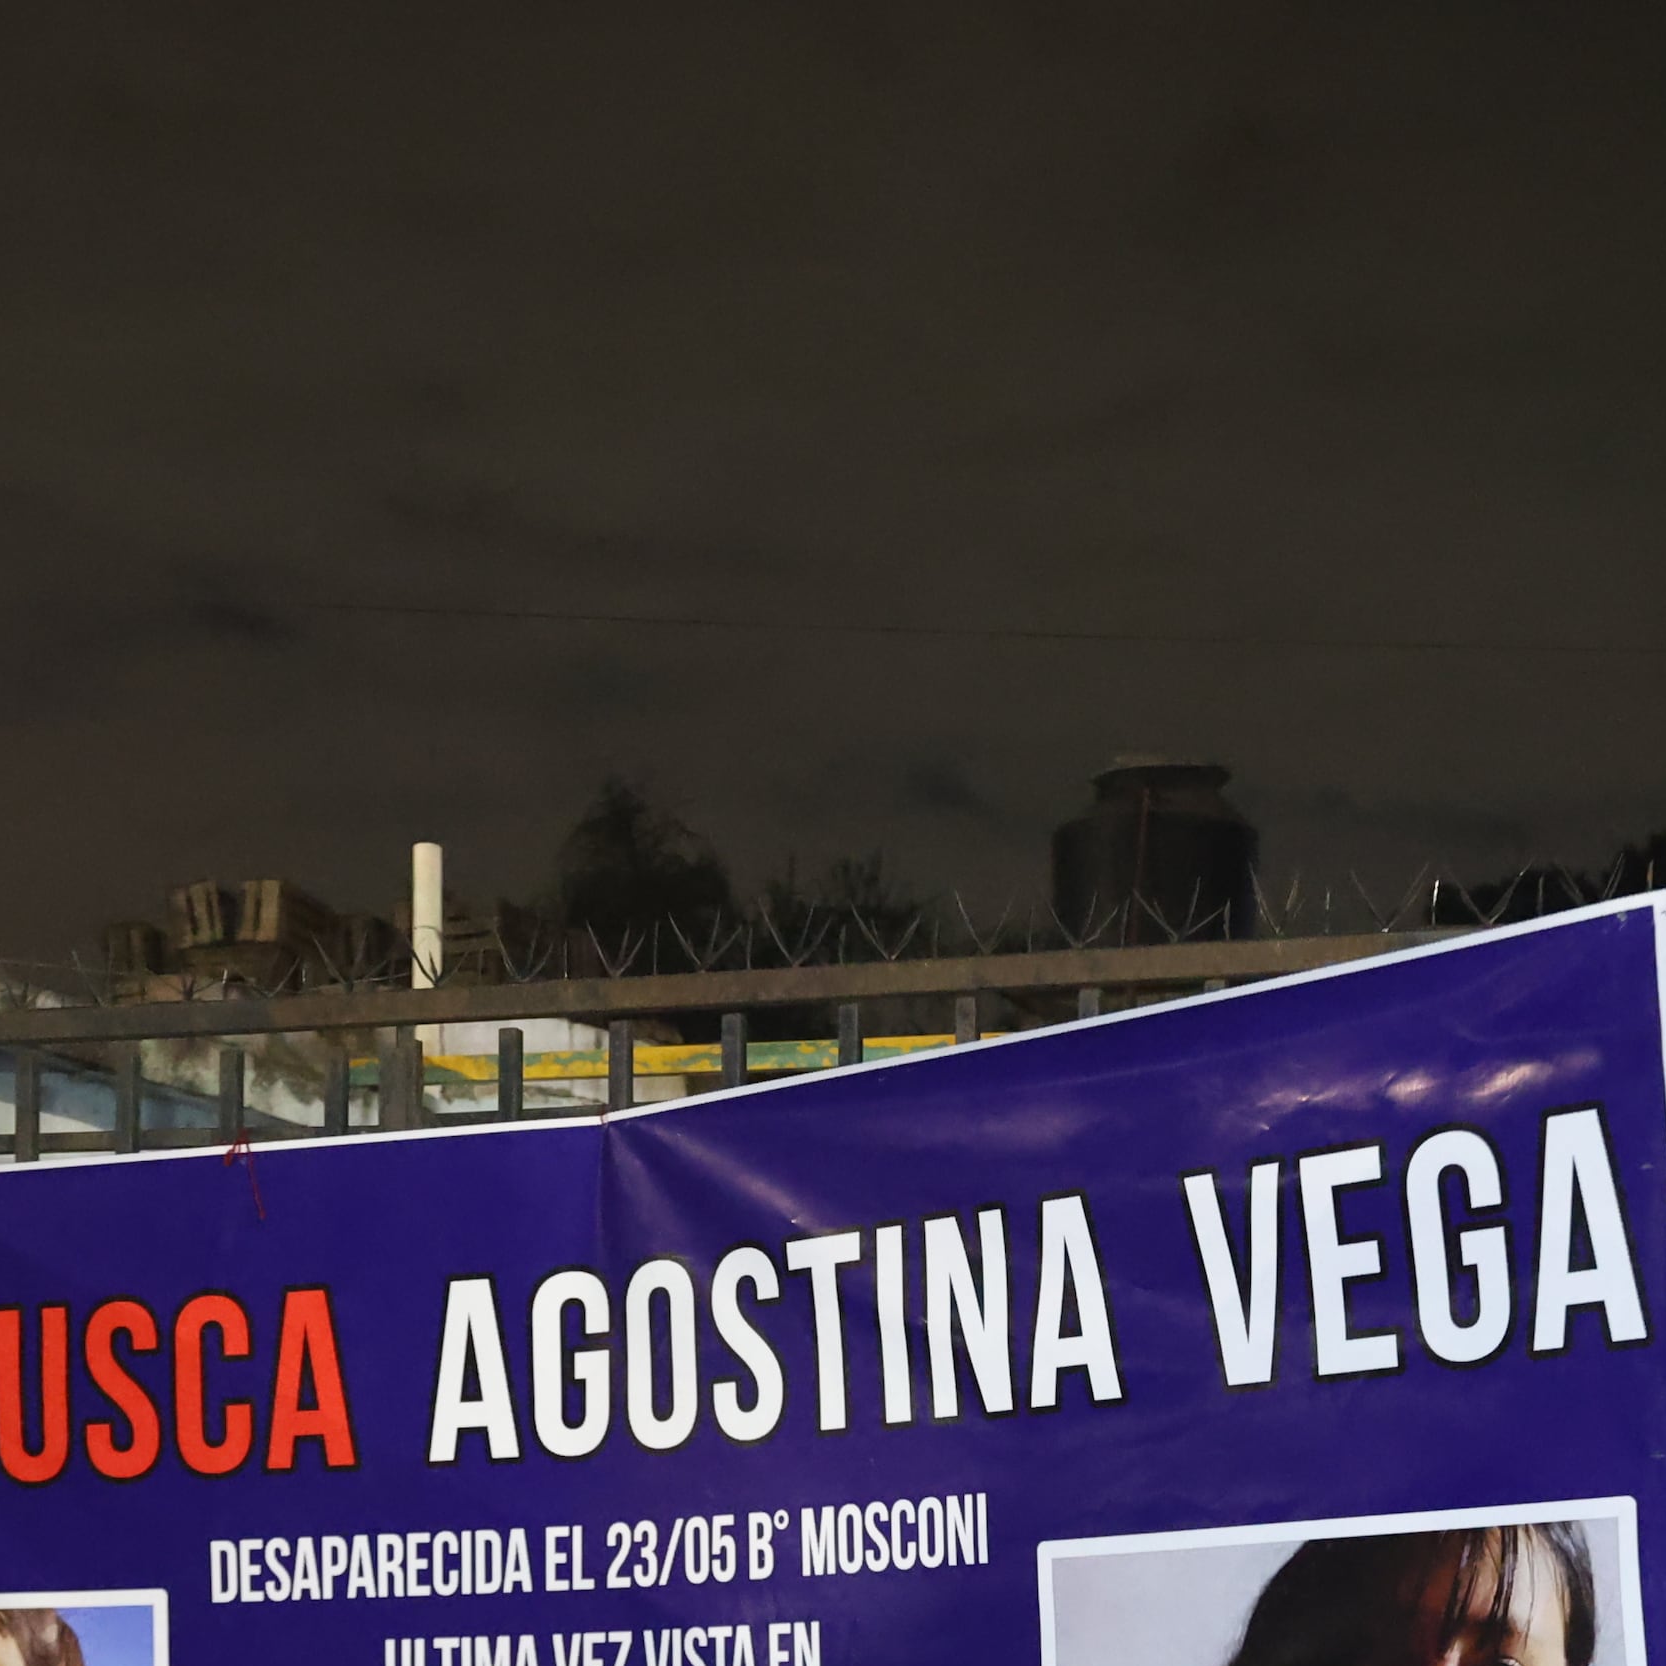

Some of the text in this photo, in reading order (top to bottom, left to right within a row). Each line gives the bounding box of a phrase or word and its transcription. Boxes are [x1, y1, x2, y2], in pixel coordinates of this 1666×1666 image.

[428, 1195, 1123, 1463] AGOSTINA
[1183, 1108, 1648, 1386] VEGA
[210, 1527, 533, 1603] DESAPARECIDA
[546, 1524, 596, 1592] EL
[606, 1513, 737, 1589] 23/05
[801, 1492, 989, 1577] MOSCONI
